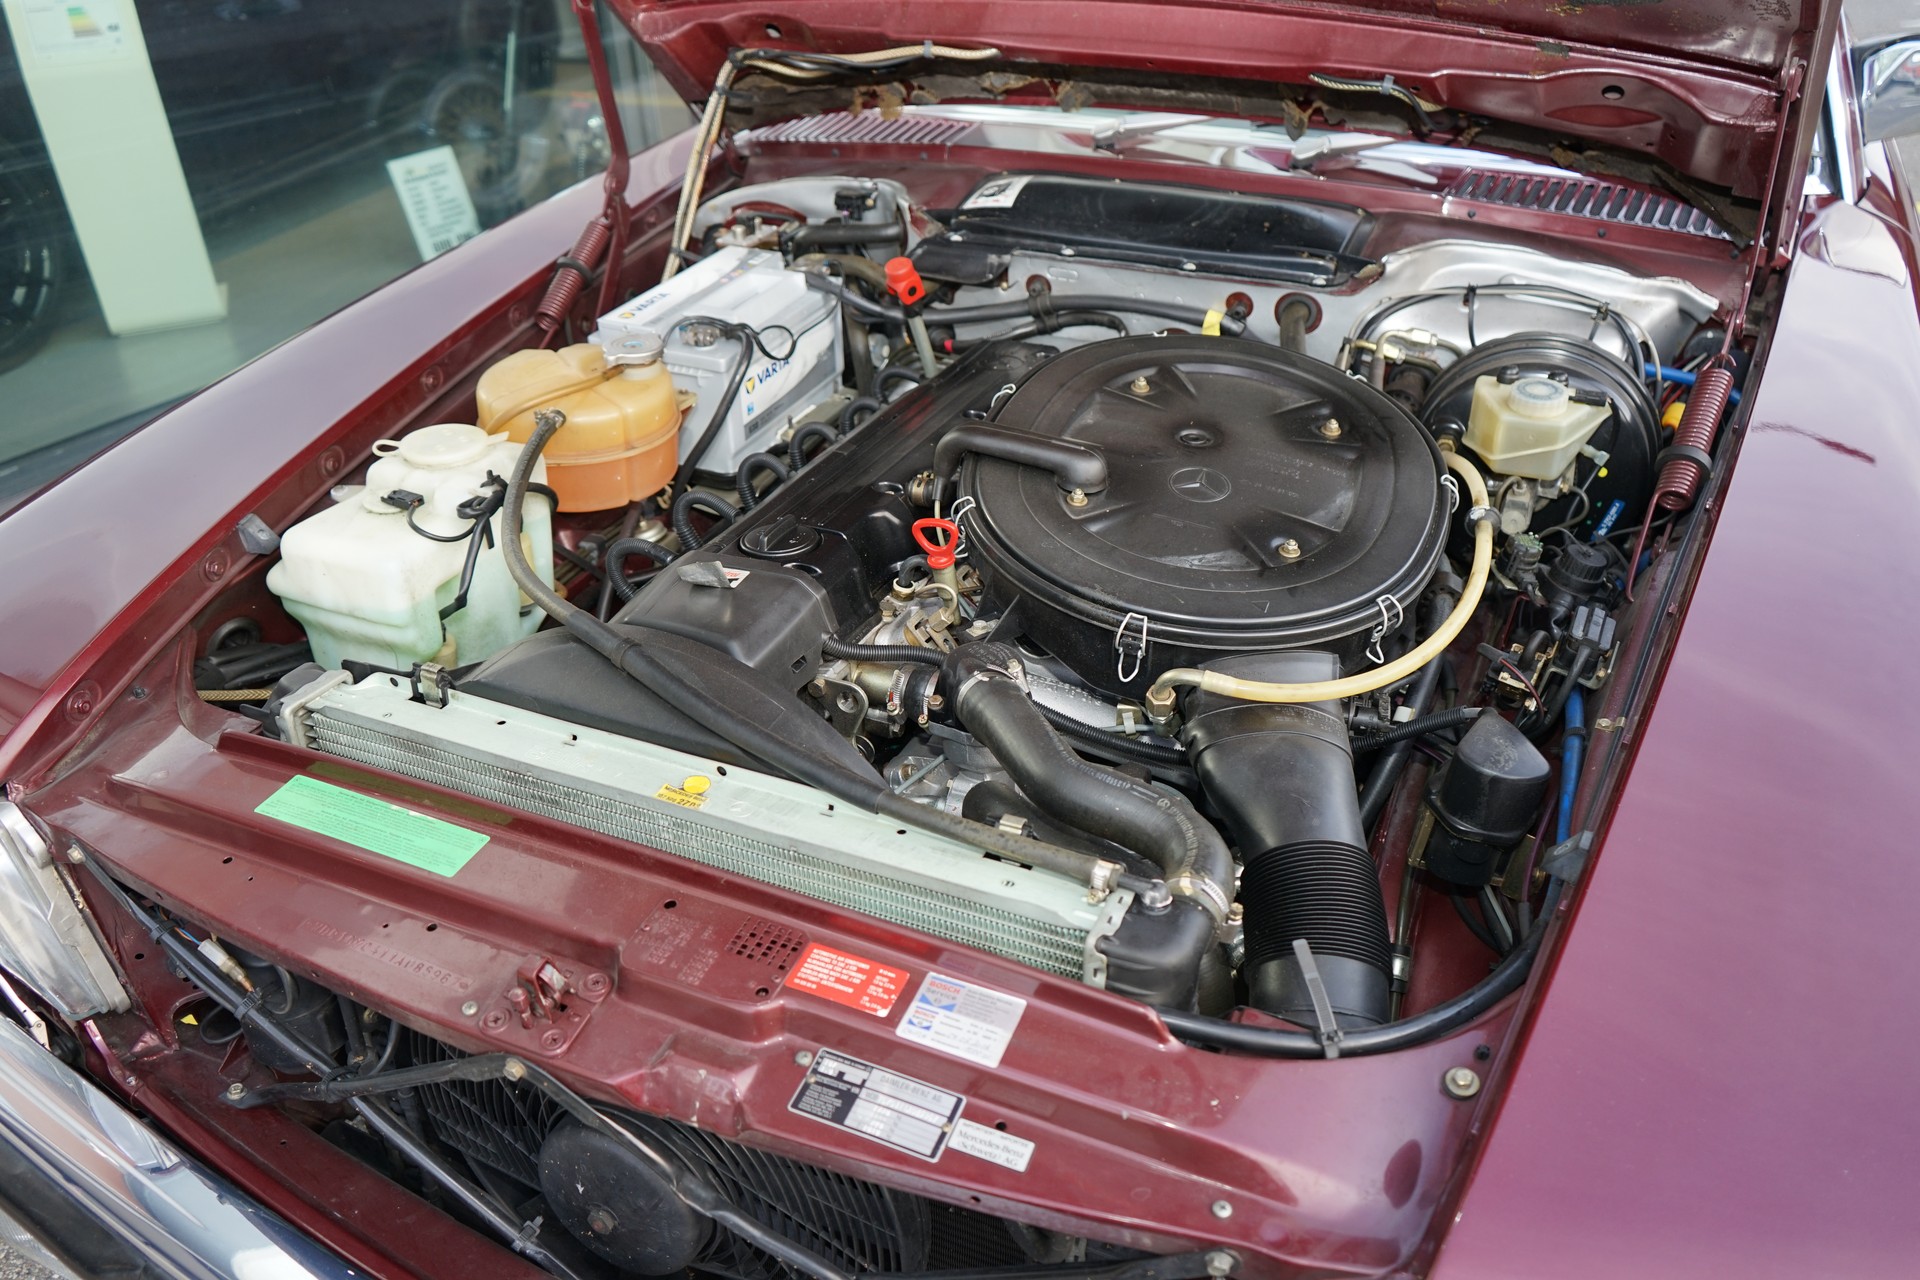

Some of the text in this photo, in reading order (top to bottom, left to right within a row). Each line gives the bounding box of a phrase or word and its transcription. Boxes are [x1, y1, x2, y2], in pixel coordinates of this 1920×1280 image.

[632, 291, 672, 312] VARTA
[756, 358, 790, 384] VARTA
[926, 987, 957, 1001] Service
[929, 980, 960, 994] BOSCH
